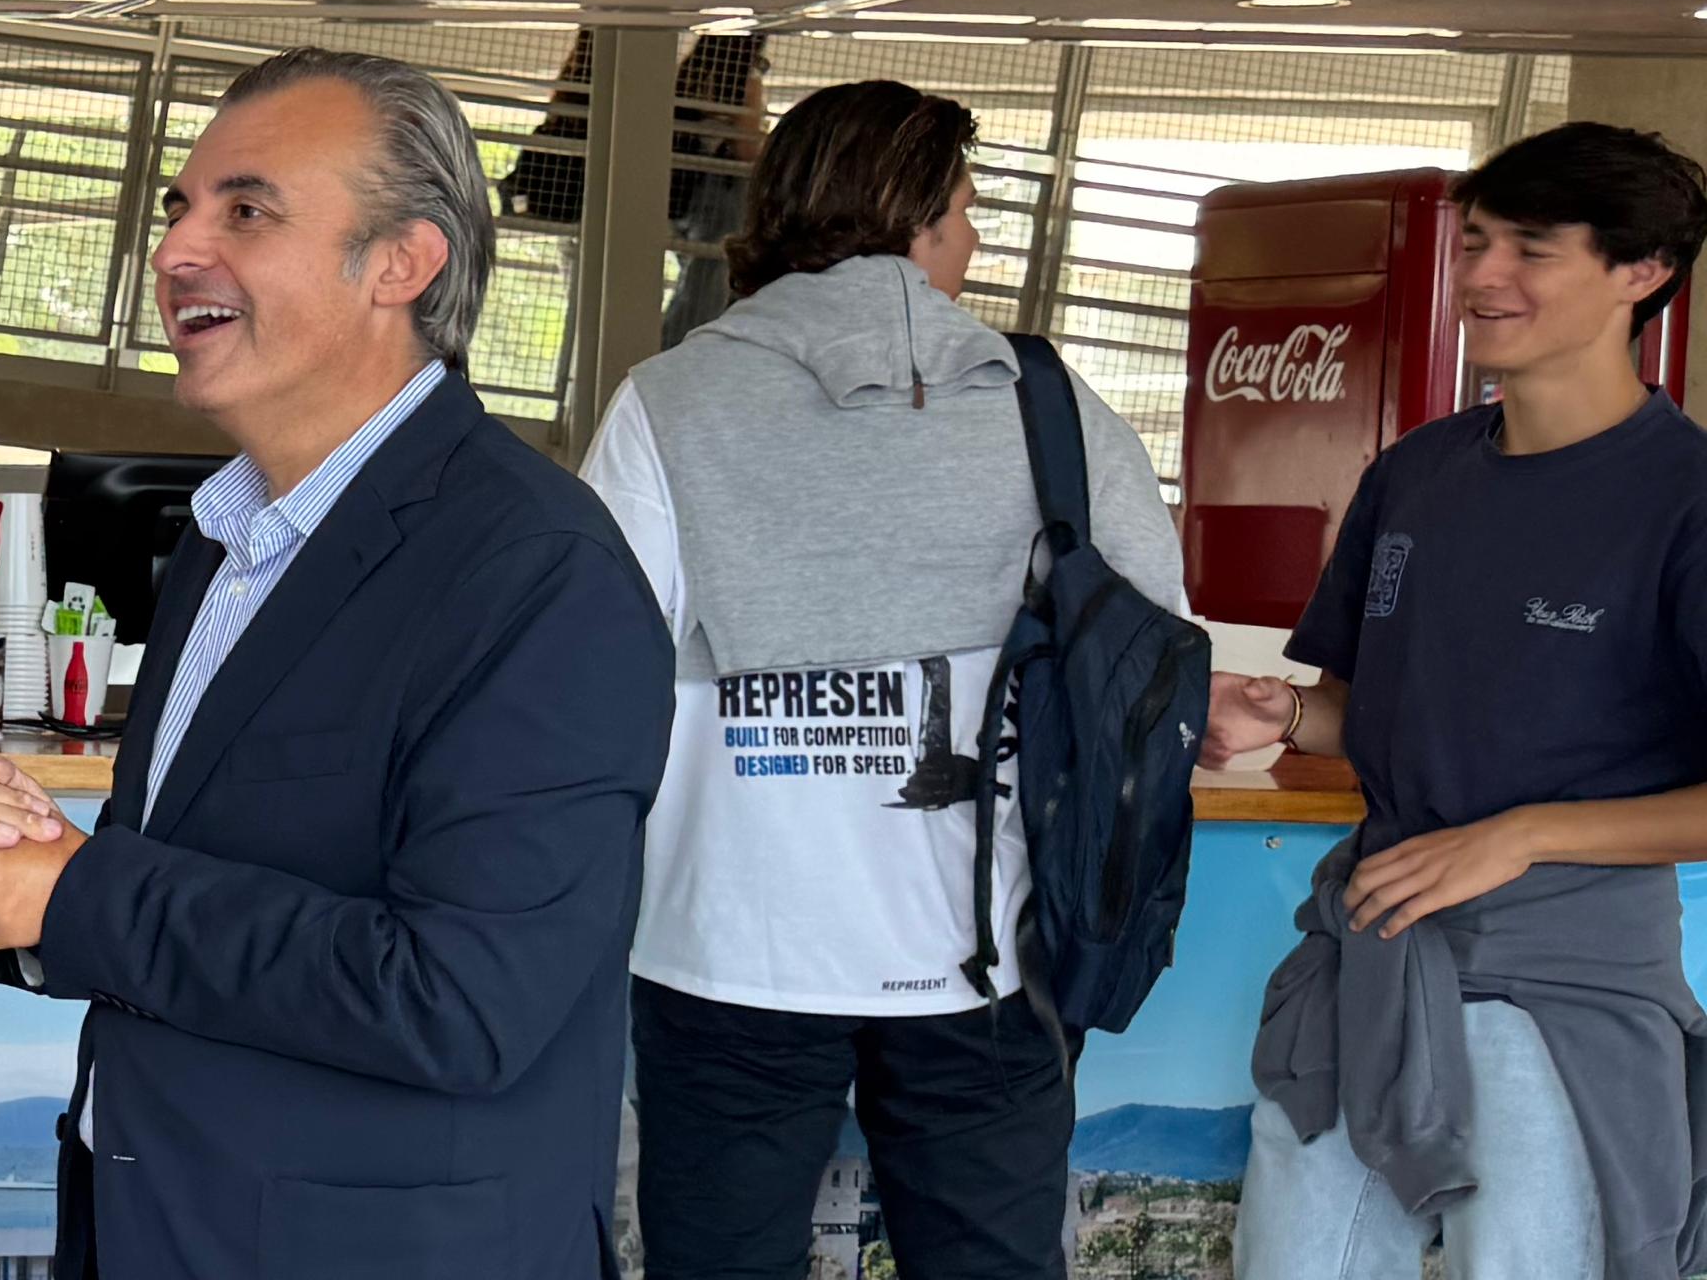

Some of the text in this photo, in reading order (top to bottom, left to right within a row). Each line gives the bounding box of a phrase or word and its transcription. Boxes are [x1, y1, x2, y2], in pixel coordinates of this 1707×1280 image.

[1205, 323, 1352, 402] Coca-Cola
[725, 726, 769, 747] BUILT
[773, 726, 799, 746] FOR
[734, 754, 912, 777] DESIGNED FOR SPEED.
[881, 977, 947, 992] REPRESENT
